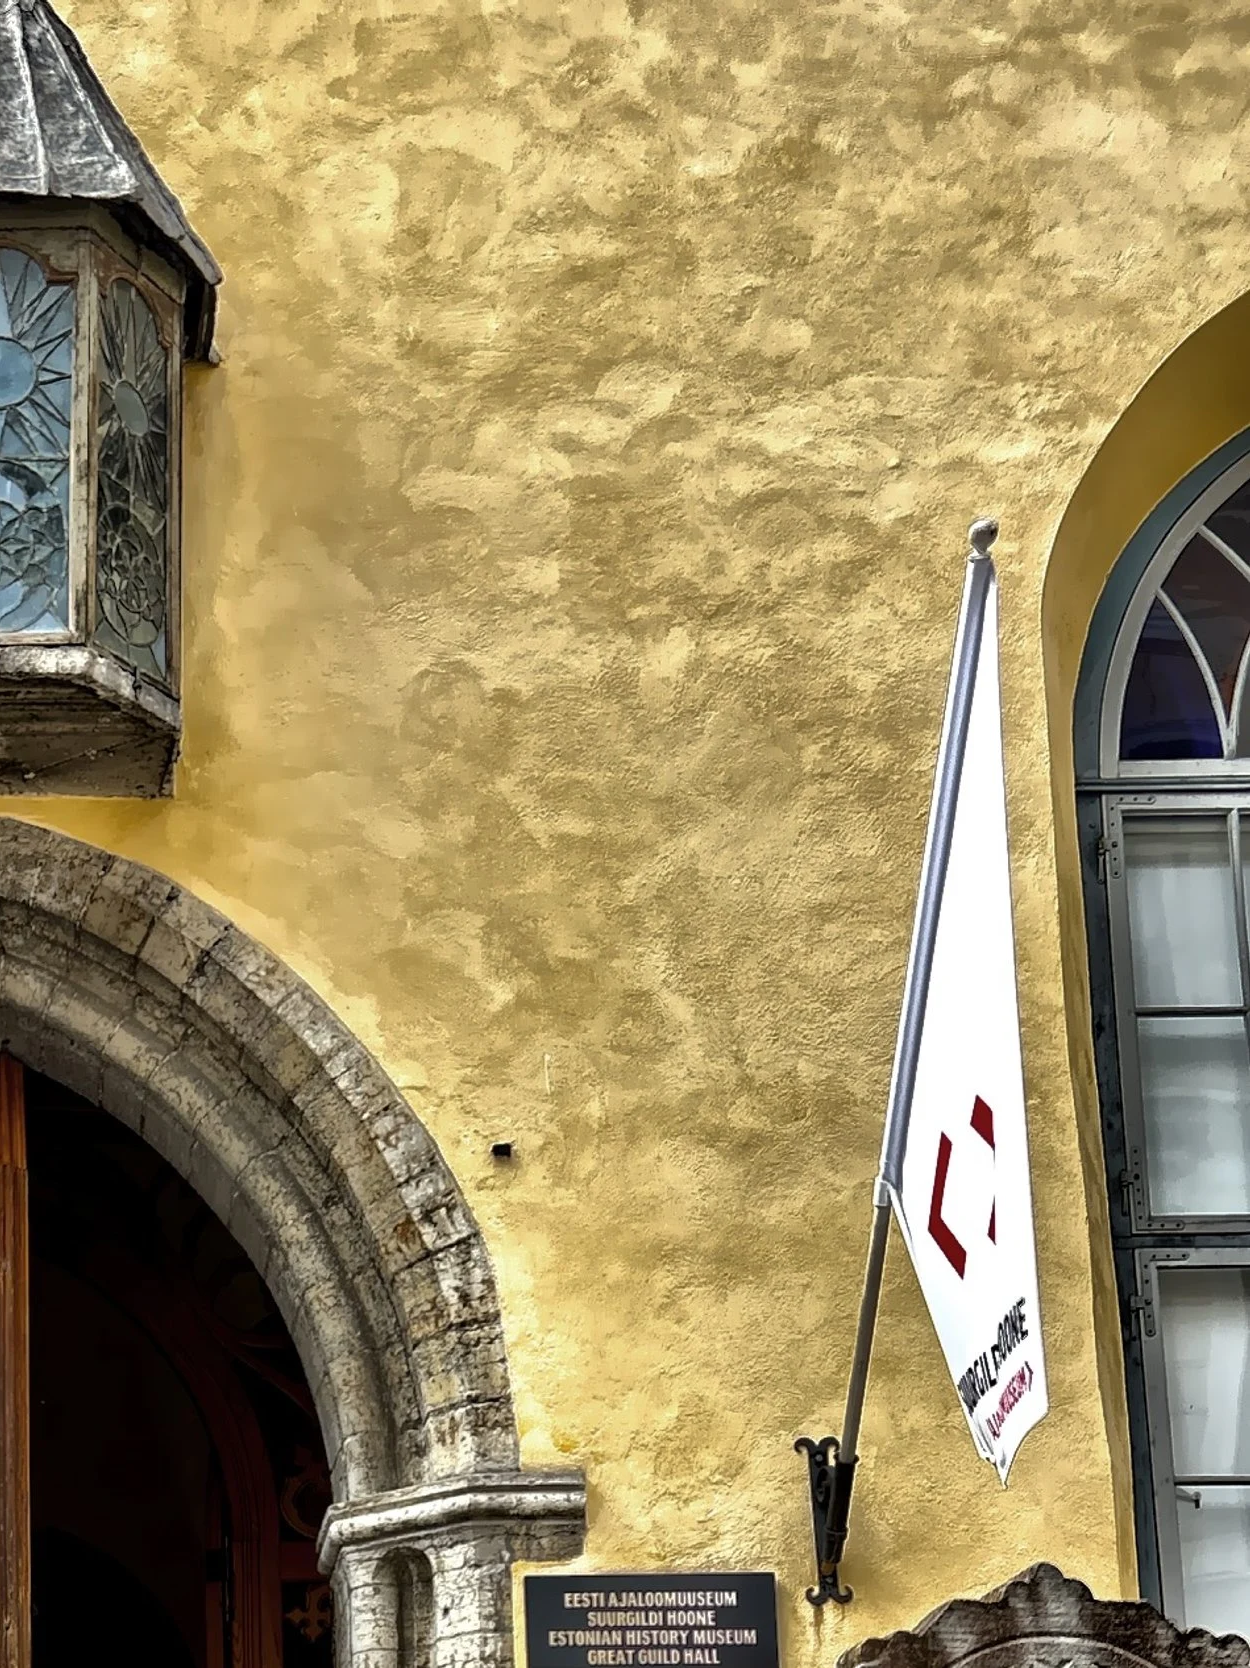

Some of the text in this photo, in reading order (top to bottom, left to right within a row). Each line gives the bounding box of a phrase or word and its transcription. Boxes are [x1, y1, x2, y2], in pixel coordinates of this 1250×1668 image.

[563, 1591, 738, 1608] EESTI AJALOOMUUSEUM
[587, 1610, 716, 1627] SUURGILDI HOONE
[548, 1629, 757, 1647] ESTONIAN HISTORY MUSEUM
[587, 1648, 721, 1666] GREAT GUILD HALL
